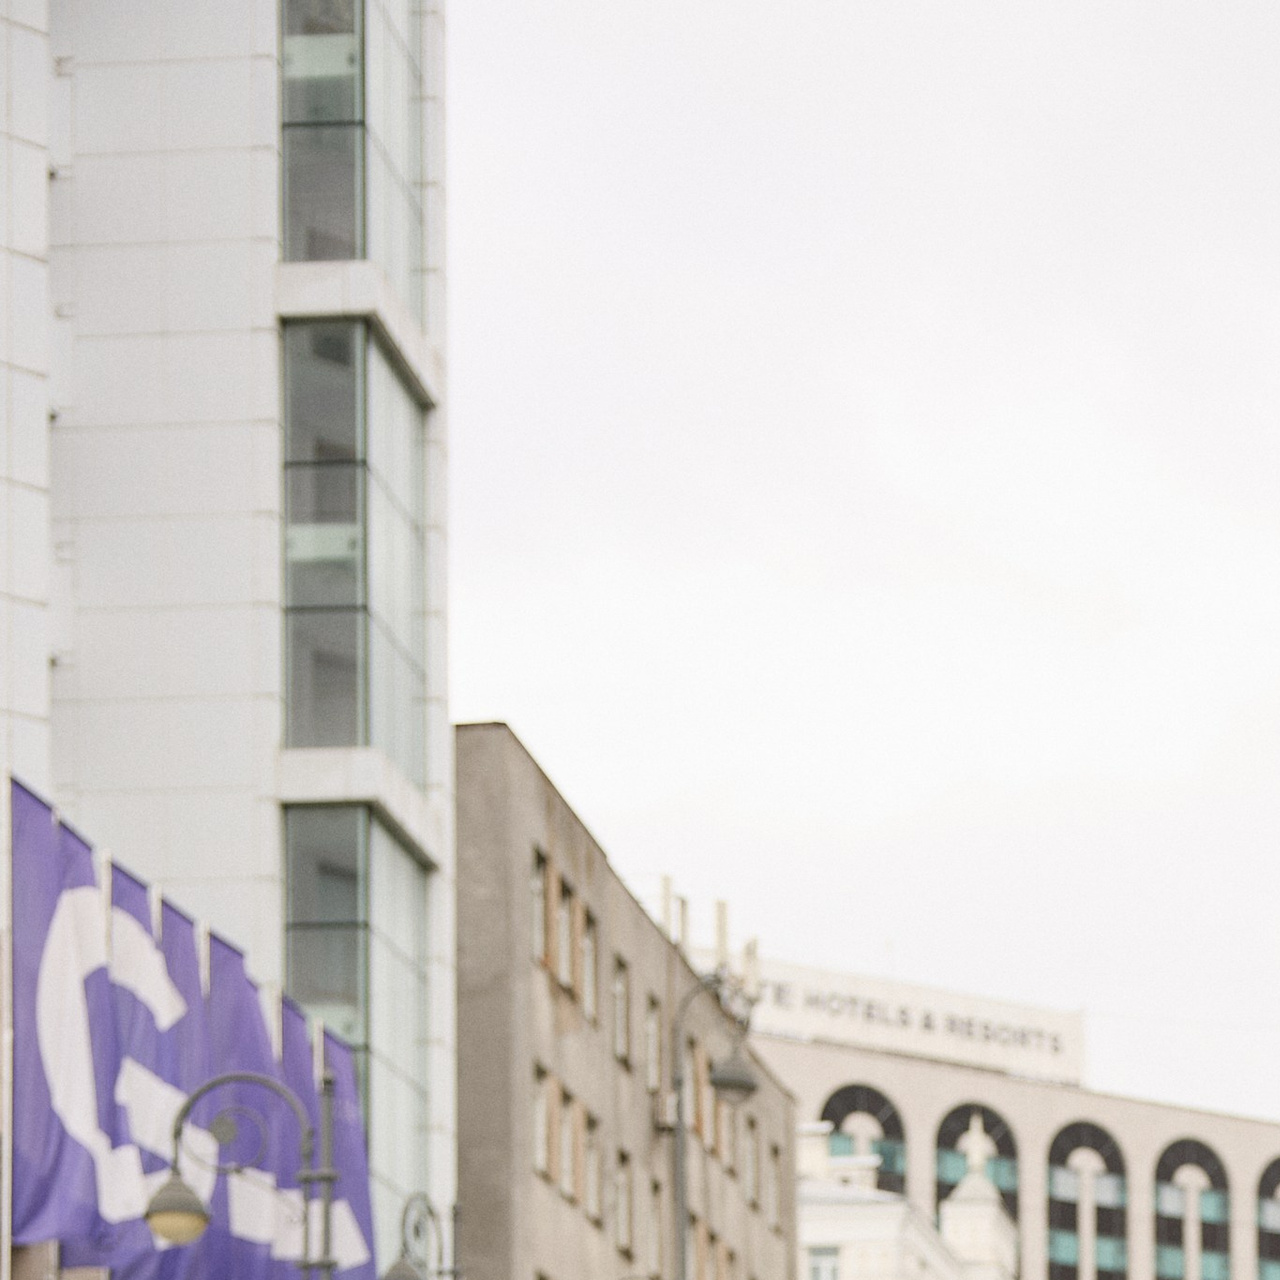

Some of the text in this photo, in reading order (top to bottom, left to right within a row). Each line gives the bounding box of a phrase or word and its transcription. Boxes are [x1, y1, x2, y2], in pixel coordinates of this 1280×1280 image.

[803, 989, 911, 1028] HOTELS
[921, 1010, 936, 1034] &
[946, 1012, 1062, 1054] RESORTS
